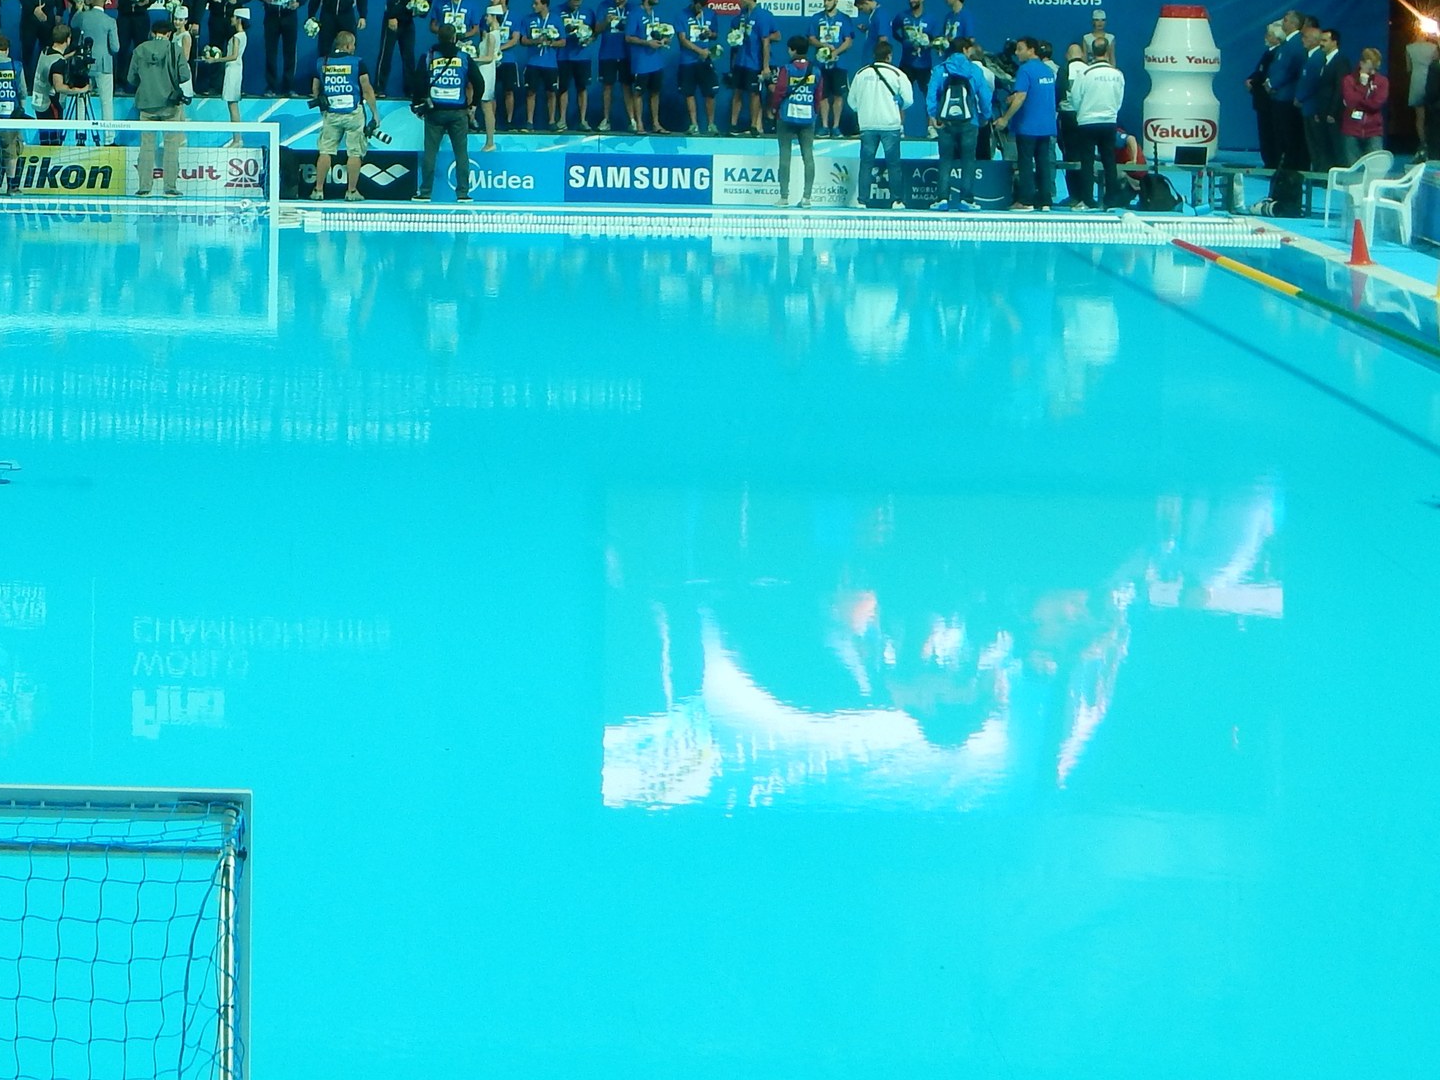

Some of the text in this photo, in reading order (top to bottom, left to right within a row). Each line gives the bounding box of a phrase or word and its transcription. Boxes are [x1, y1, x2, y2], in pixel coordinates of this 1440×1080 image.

[708, 2, 741, 11] OMEGA
[324, 75, 349, 84] POOL
[324, 84, 353, 93] PHOTO
[1150, 123, 1209, 139] Yakult
[468, 170, 534, 190] Midea
[568, 165, 711, 190] SAMSUNG
[724, 168, 780, 182] KAZA
